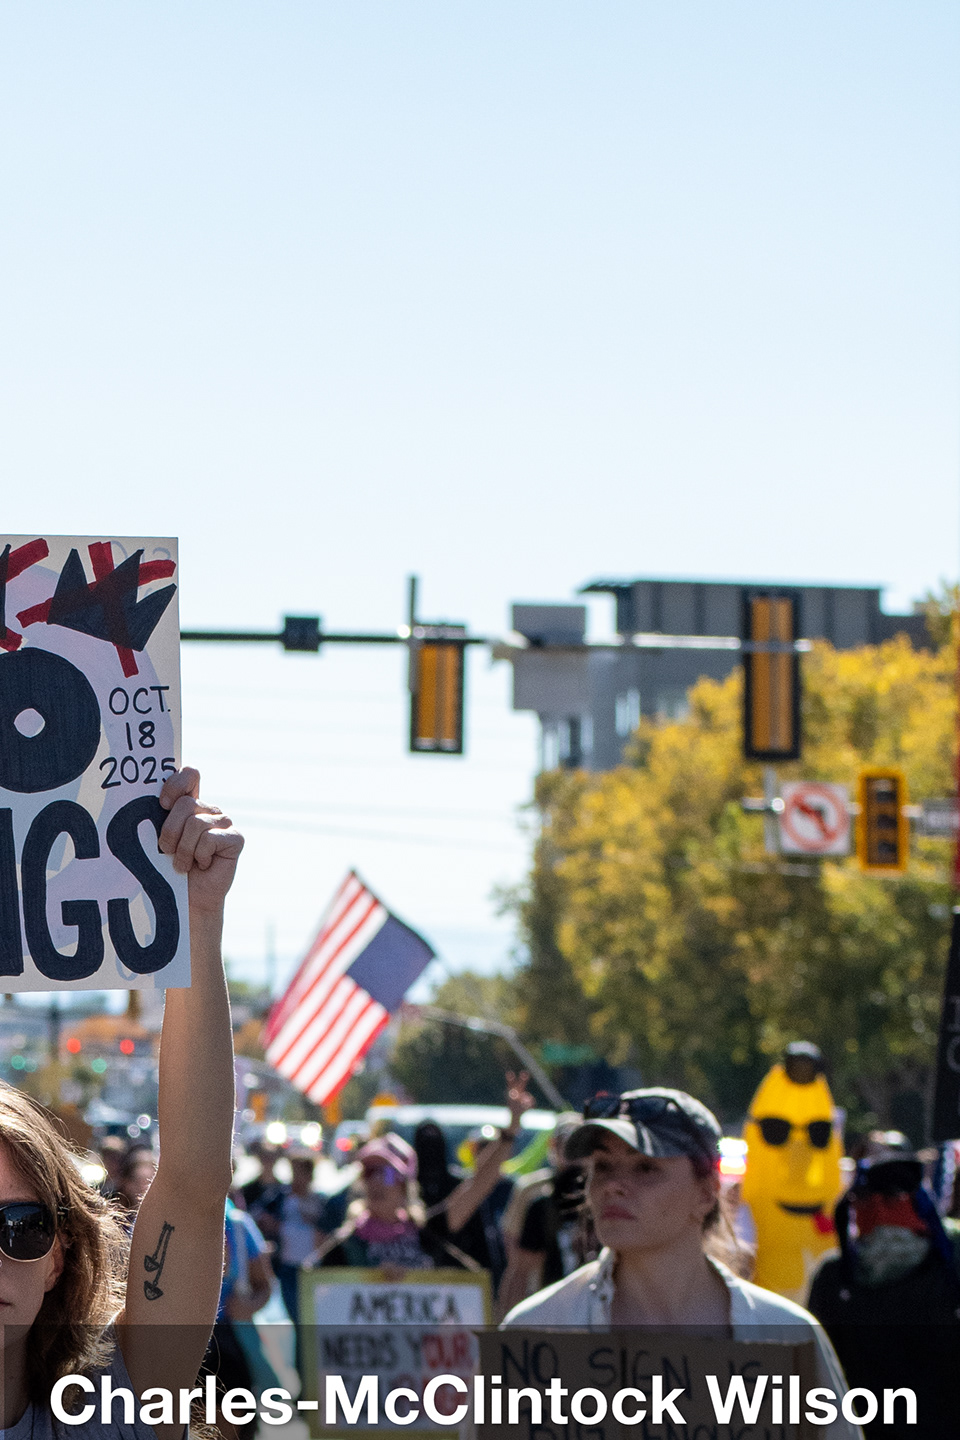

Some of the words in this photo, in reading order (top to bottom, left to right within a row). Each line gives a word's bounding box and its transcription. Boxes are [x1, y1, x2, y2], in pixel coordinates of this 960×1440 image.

[108, 685, 172, 716] OCT.
[126, 720, 156, 751] 18
[99, 755, 177, 790] 2025
[348, 1291, 462, 1323] AMERICA
[322, 1331, 394, 1369] NEEDS
[406, 1331, 473, 1370] YOUR
[500, 1338, 559, 1386] NO
[588, 1346, 693, 1401] SIGN
